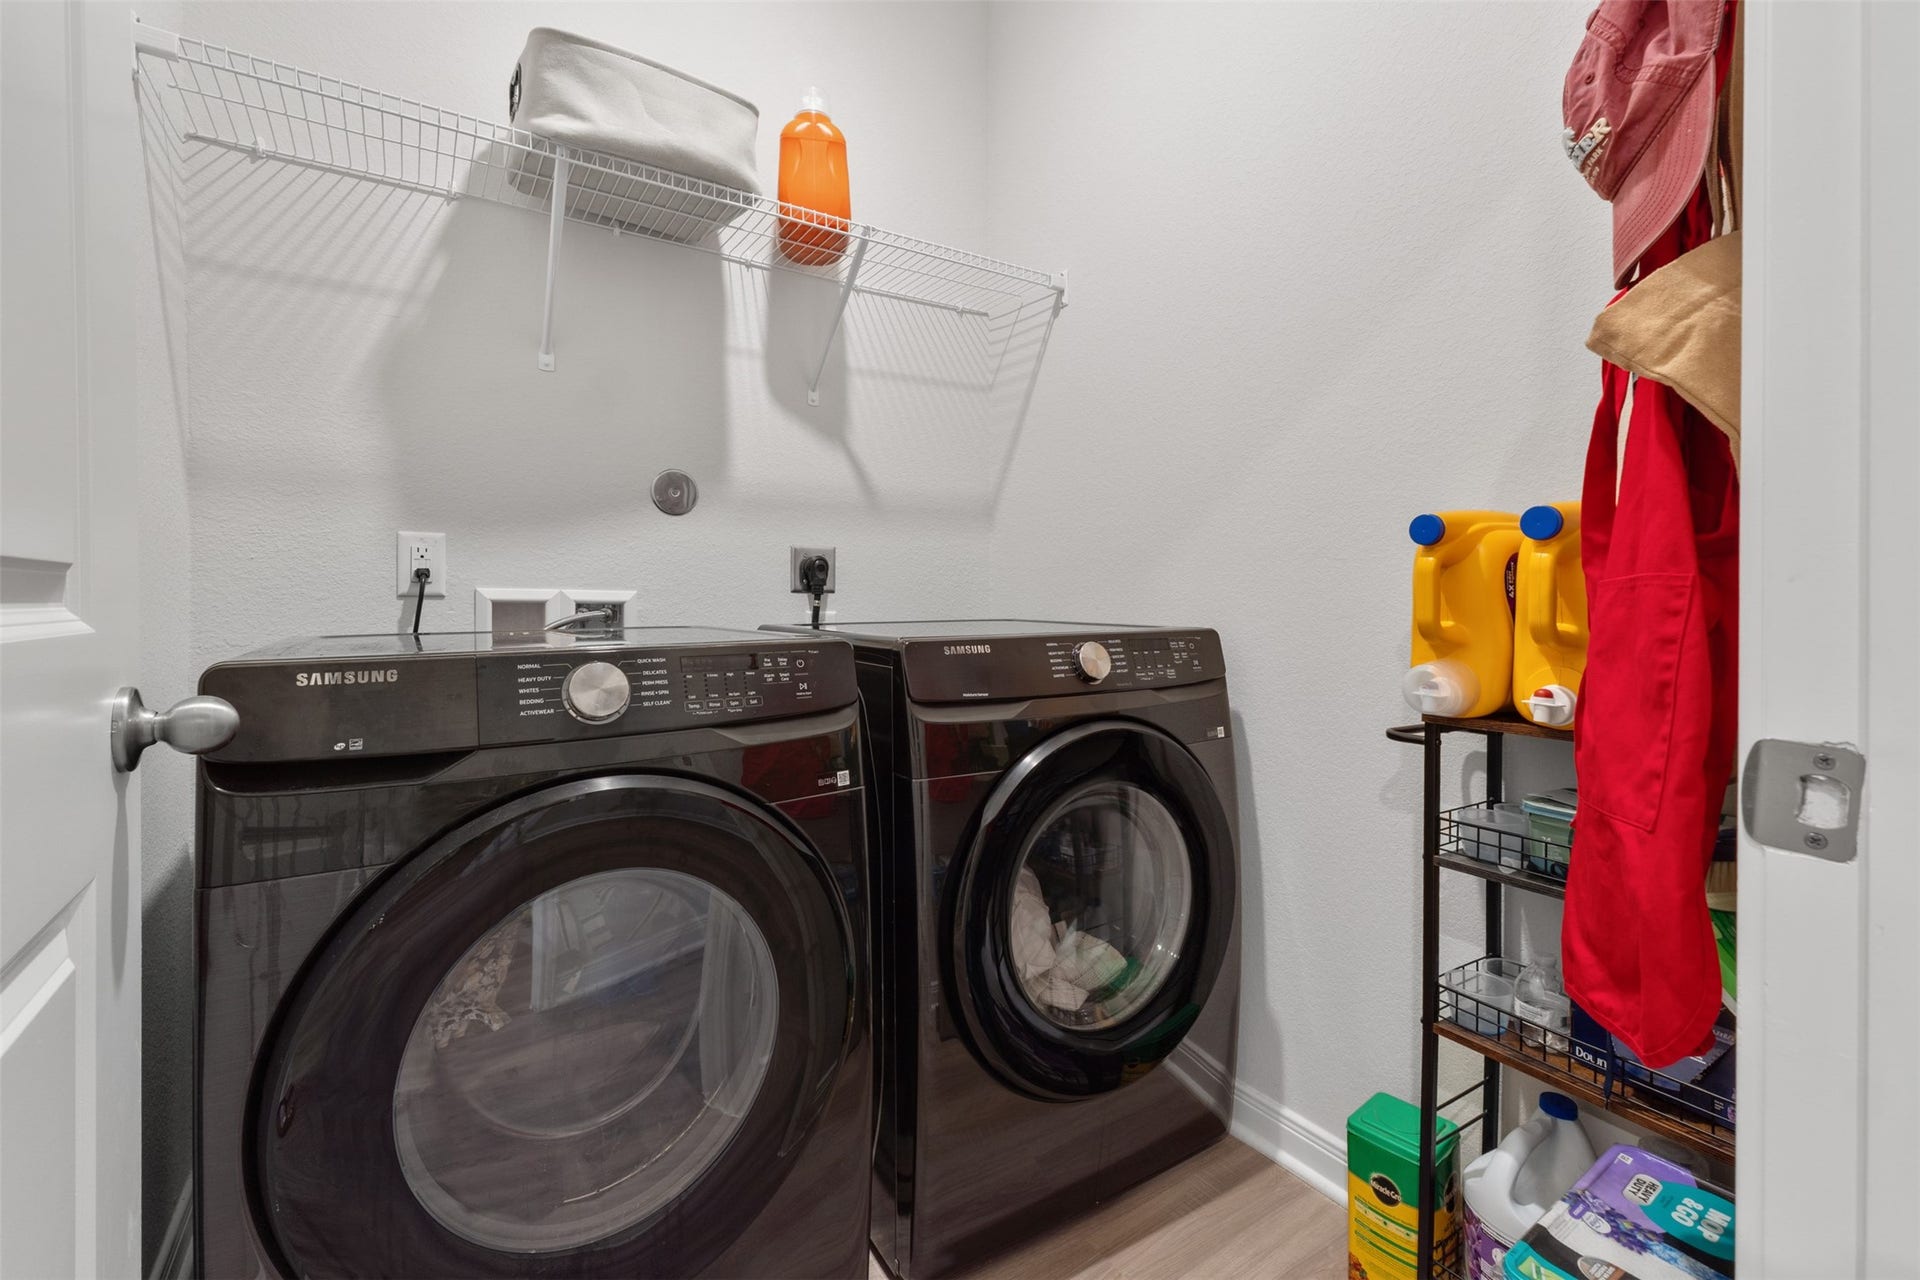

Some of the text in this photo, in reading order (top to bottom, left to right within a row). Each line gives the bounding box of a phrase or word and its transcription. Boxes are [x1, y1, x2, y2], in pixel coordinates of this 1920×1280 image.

[943, 644, 991, 655] SAMSUNG
[296, 669, 398, 687] SAMSUNG
[519, 697, 545, 705] BEDDING
[520, 708, 555, 716] ACTIVEWEAR
[1575, 1046, 1607, 1068] Down
[1628, 1178, 1647, 1196] DUTY
[1638, 1181, 1660, 1204] HEAVY
[1697, 1207, 1732, 1242] MOP
